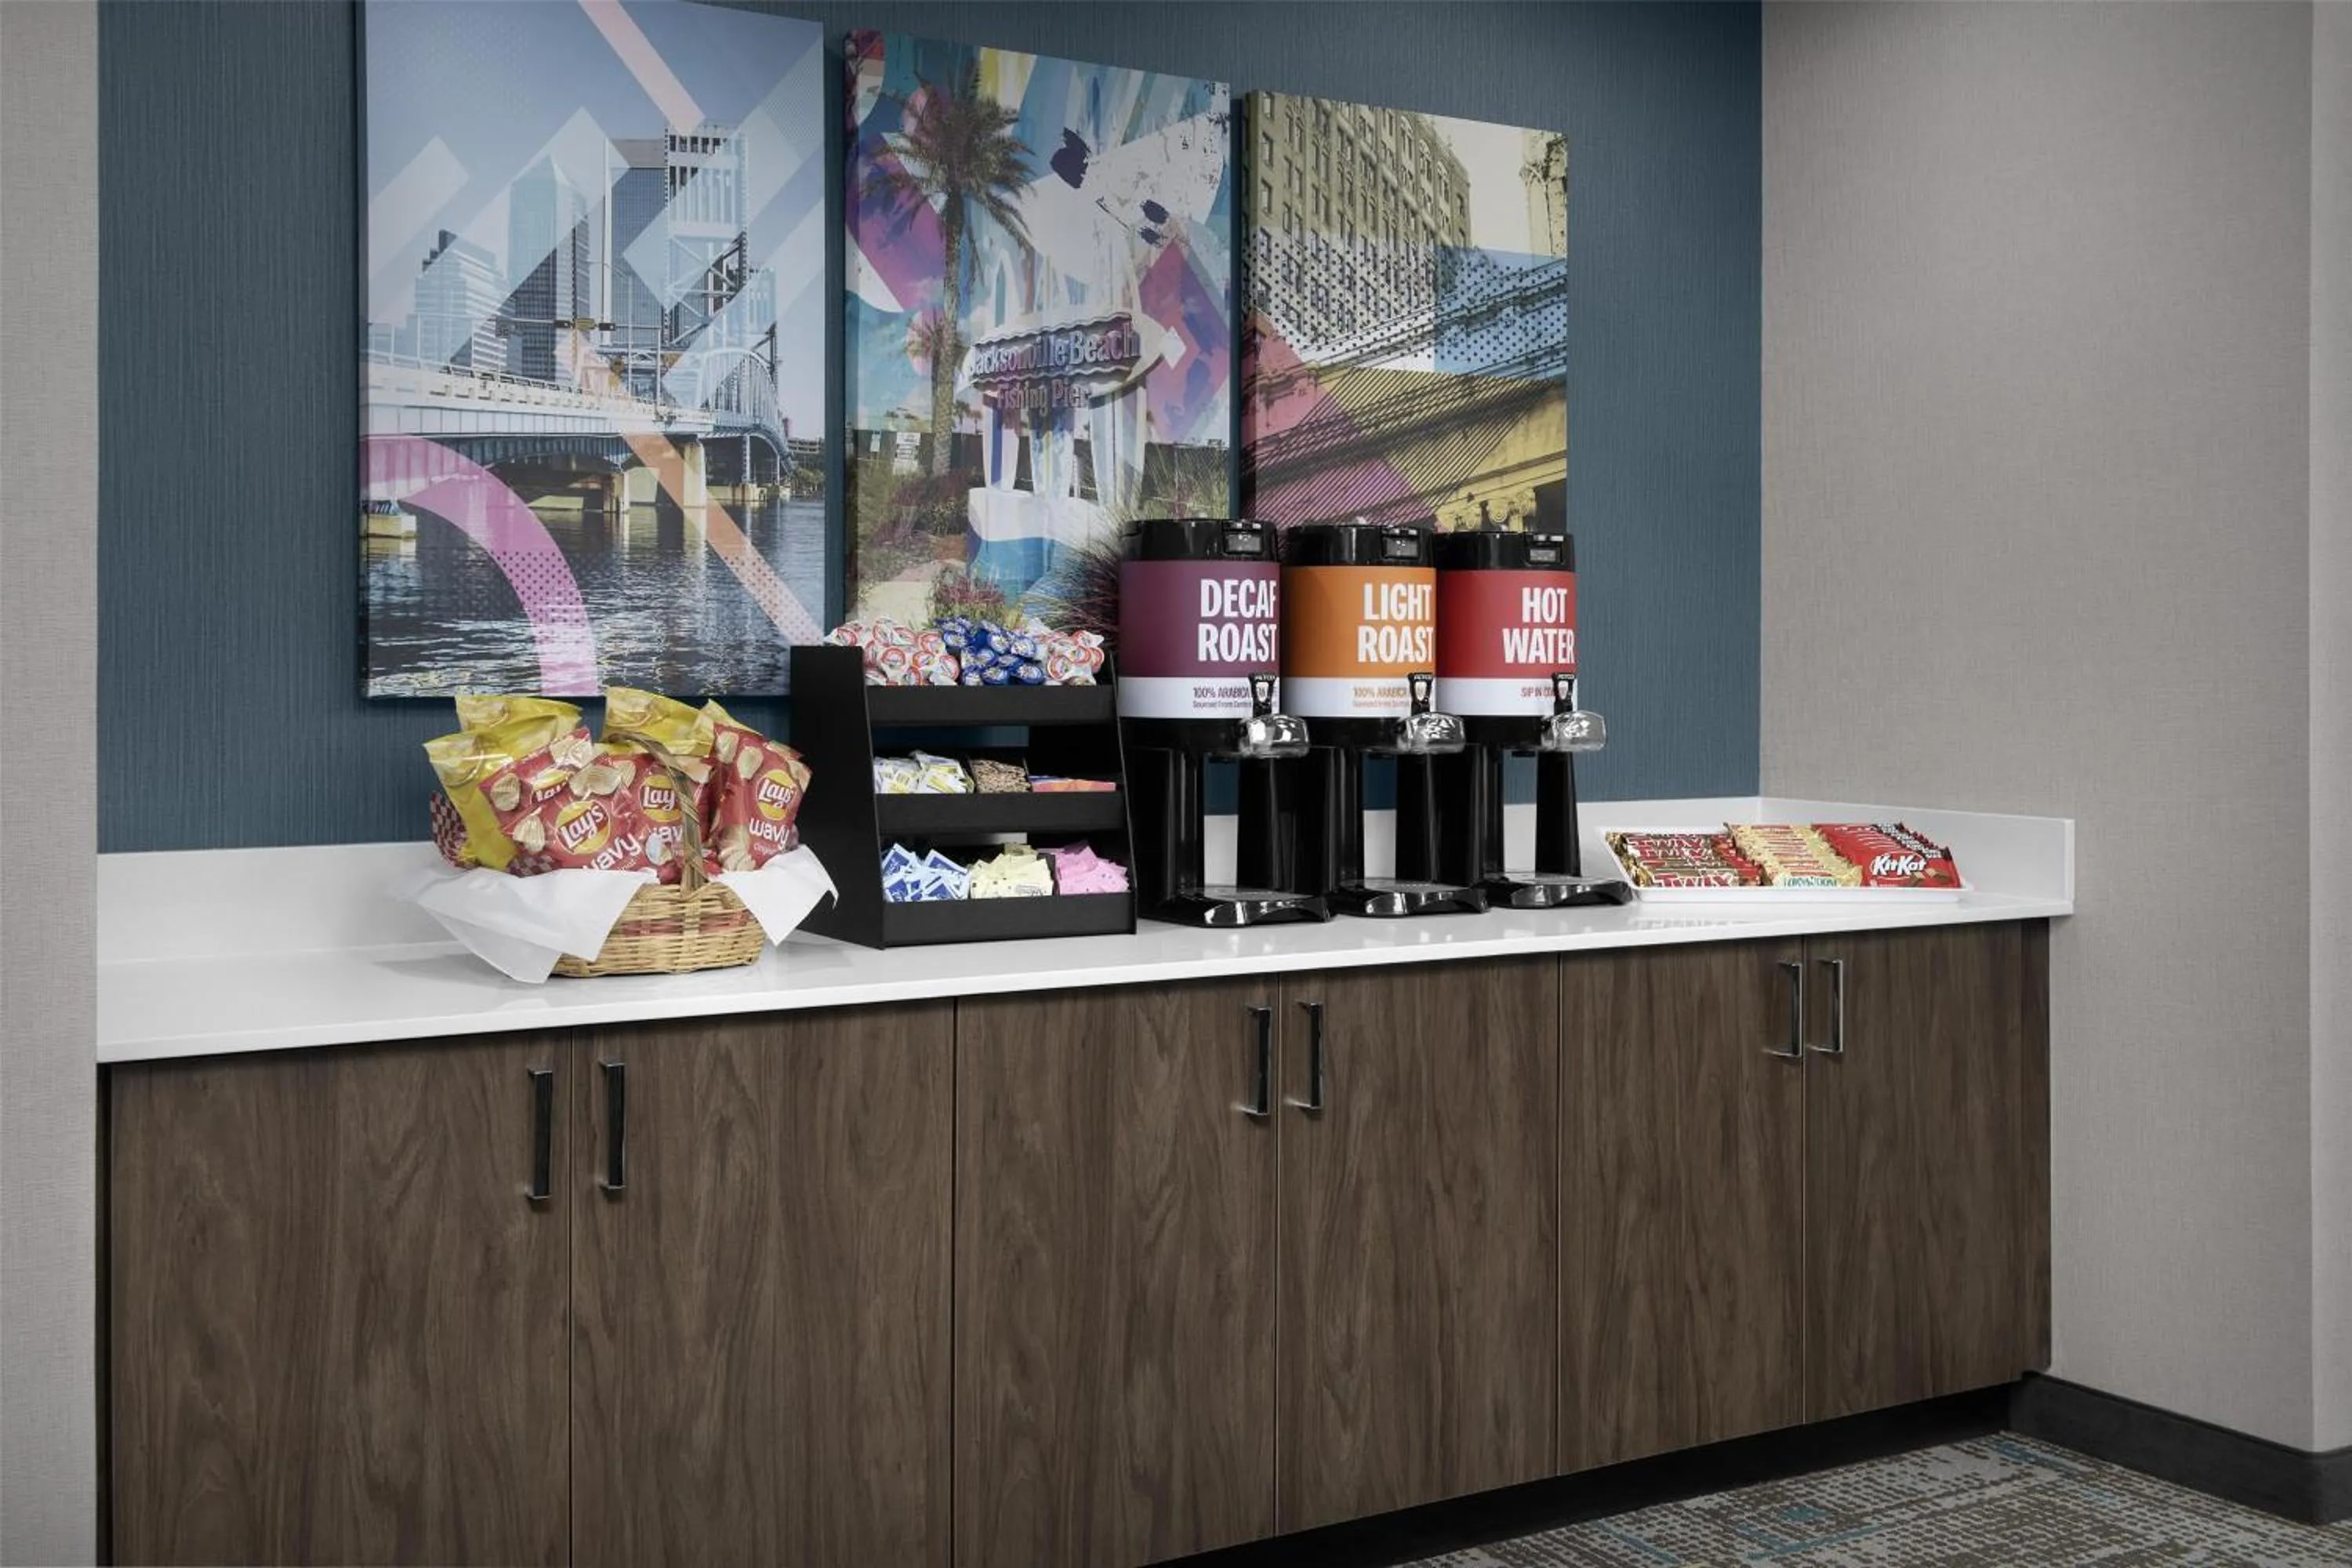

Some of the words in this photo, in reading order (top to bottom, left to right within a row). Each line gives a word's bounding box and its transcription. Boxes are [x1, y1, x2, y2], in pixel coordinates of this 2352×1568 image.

[968, 333, 1068, 375] Jacksonville
[1068, 321, 1142, 365] Beach
[996, 380, 1048, 417] Fishing
[1051, 379, 1091, 408] Pier
[1200, 579, 1276, 618] DECAF
[1363, 583, 1432, 621] LIGHT
[1522, 586, 1567, 624] HOT
[1198, 622, 1277, 662] ROAST
[1357, 625, 1434, 663] ROAST
[1502, 627, 1575, 664] WATER
[642, 786, 676, 811] Lay
[749, 817, 790, 851] wavy
